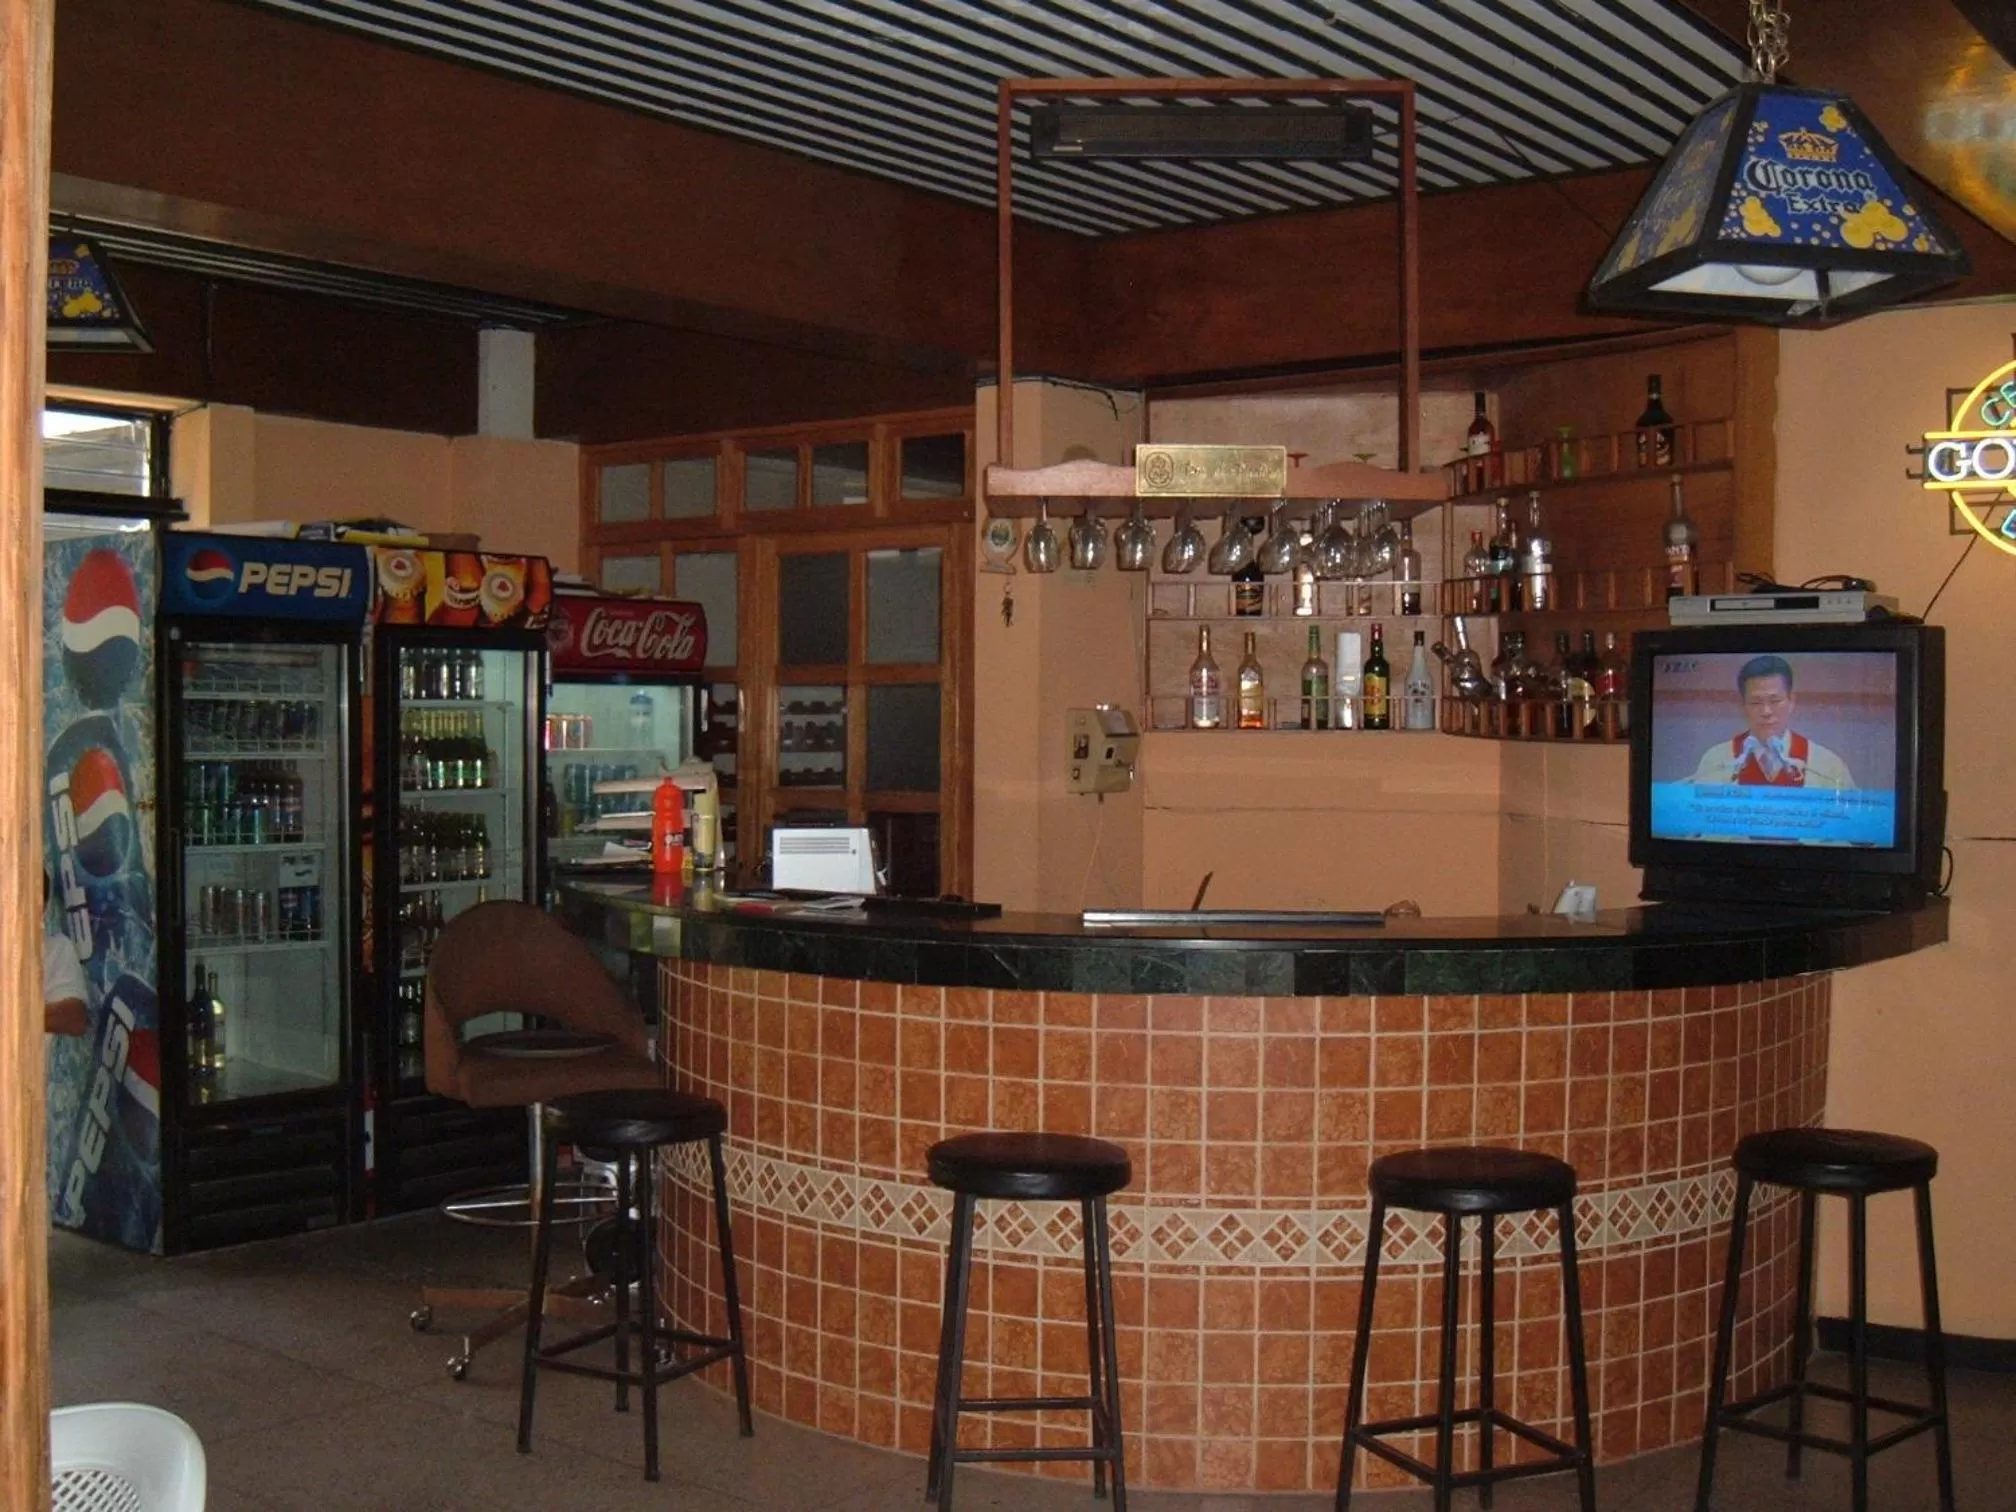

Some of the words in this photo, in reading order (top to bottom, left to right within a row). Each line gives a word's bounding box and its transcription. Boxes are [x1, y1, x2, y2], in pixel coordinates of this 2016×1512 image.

[1744, 157, 1876, 196] Corona
[1785, 190, 1861, 213] Extra
[1929, 437, 2016, 482] GO
[238, 561, 353, 598] PEPSI
[580, 607, 697, 661] Coca-Cola
[50, 772, 93, 961] EPSI
[64, 996, 136, 1228] PEPSI
